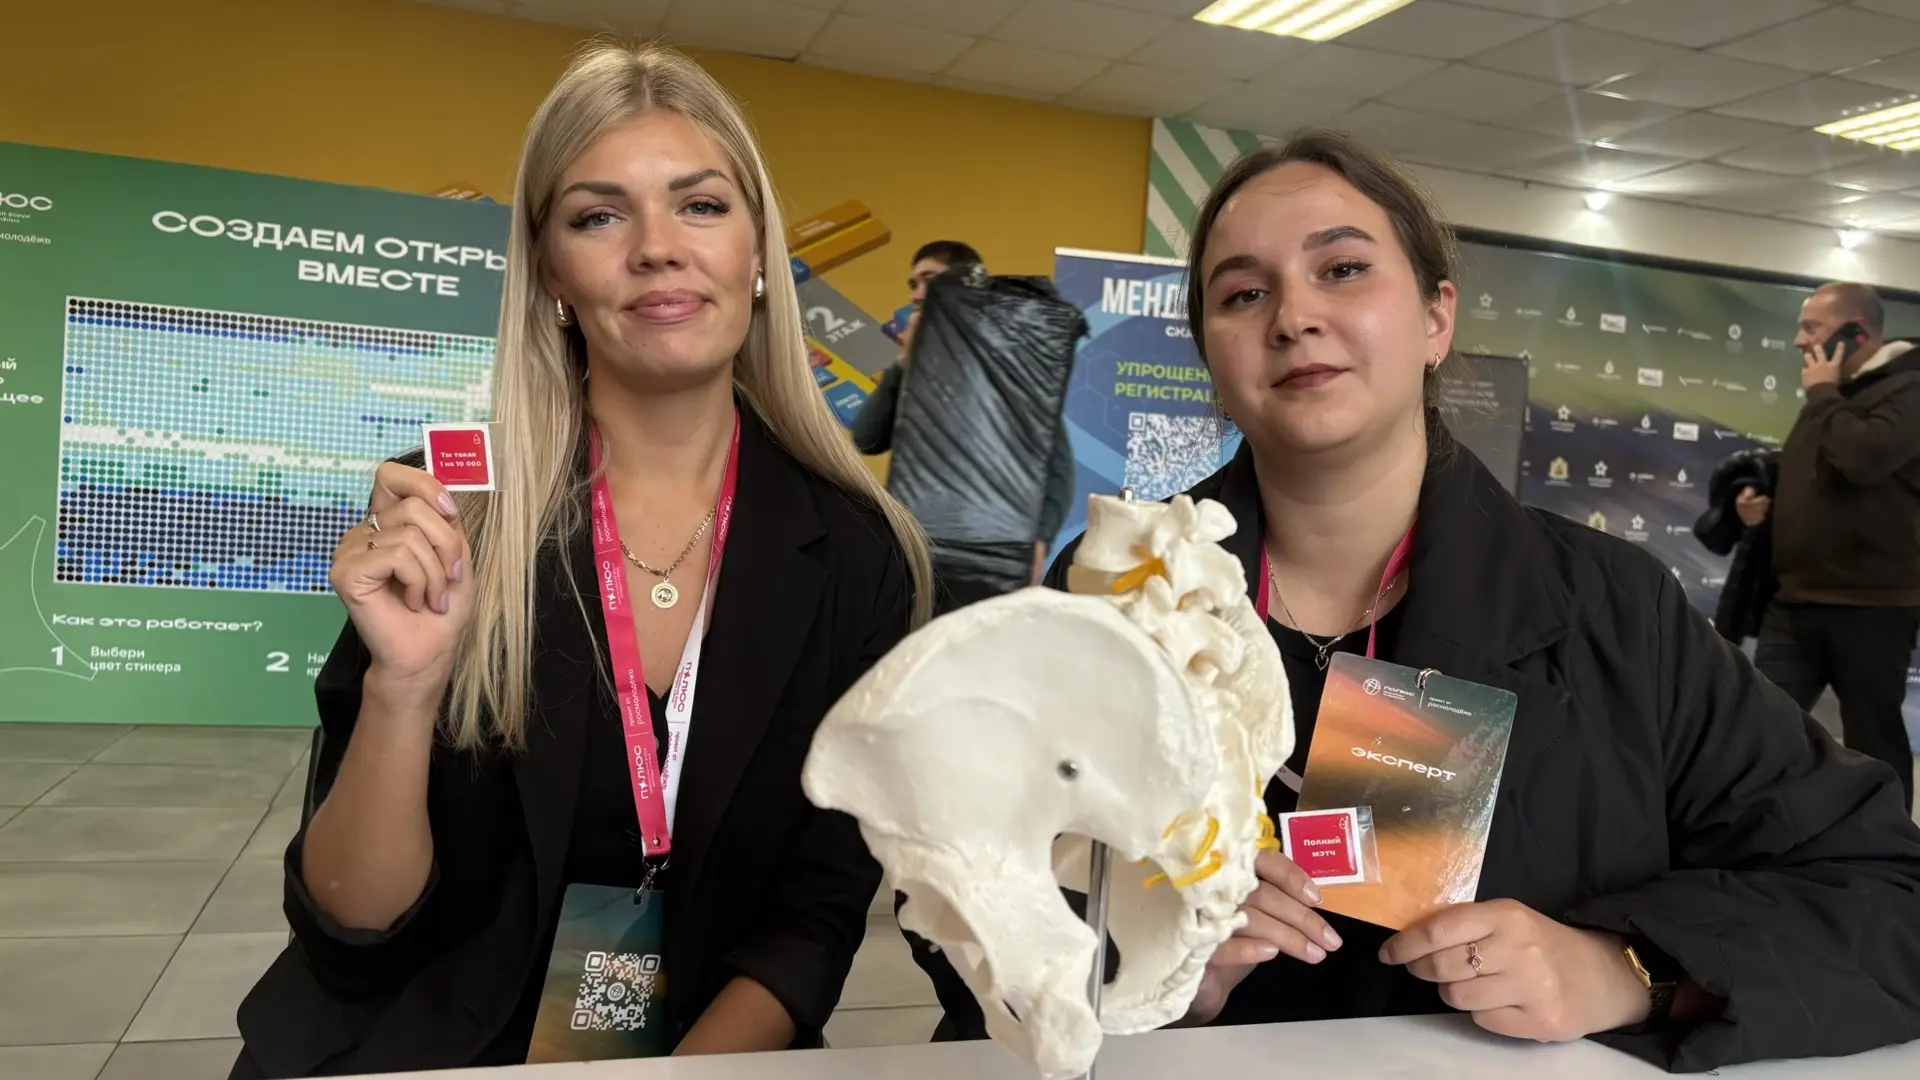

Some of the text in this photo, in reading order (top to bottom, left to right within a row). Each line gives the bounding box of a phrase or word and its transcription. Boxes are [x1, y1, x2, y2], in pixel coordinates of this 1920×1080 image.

[152, 211, 365, 255] СОЗДАЕМ
[298, 259, 460, 296] ВМЕСТЕ
[806, 306, 846, 333] 2
[603, 560, 617, 611] ПЛЮС
[52, 613, 263, 632] Как это работает?
[51, 645, 64, 666] 1
[90, 645, 145, 659] Выбери
[265, 650, 290, 672] 2
[90, 661, 182, 675] цвет стикера
[677, 661, 692, 713] ПЛЮС
[634, 745, 648, 800] ПЛЮС
[1303, 836, 1342, 846] Полный
